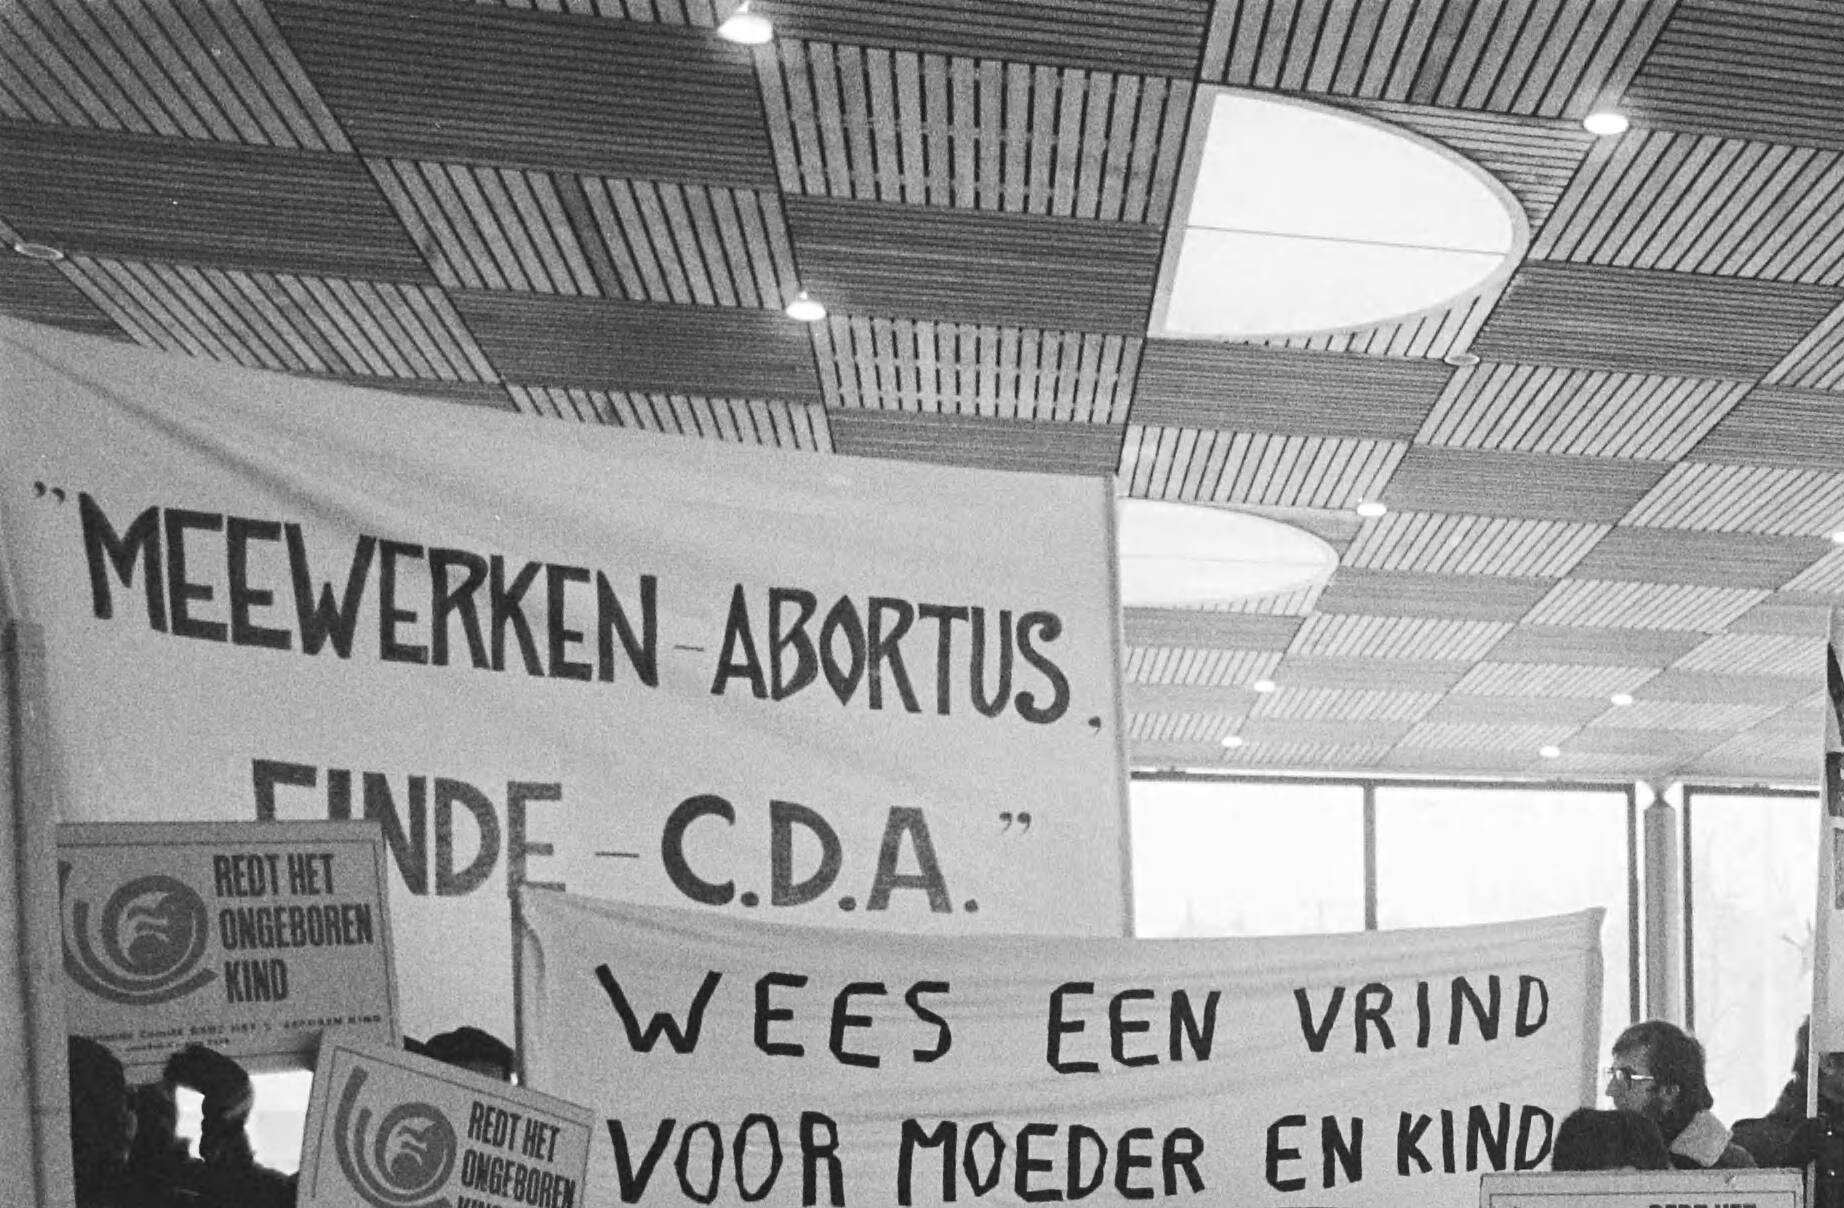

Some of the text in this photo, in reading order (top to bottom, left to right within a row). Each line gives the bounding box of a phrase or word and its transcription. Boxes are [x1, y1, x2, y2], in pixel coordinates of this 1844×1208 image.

[213, 854, 334, 898] REDT HET
[218, 903, 374, 950] ONGEBOREN
[224, 959, 289, 1003] KIND
[595, 963, 1549, 1074] WEES EEN VRIND
[467, 1101, 560, 1163] REDT HET
[607, 1101, 1555, 1208] VOOR MOEDER EN KIND
